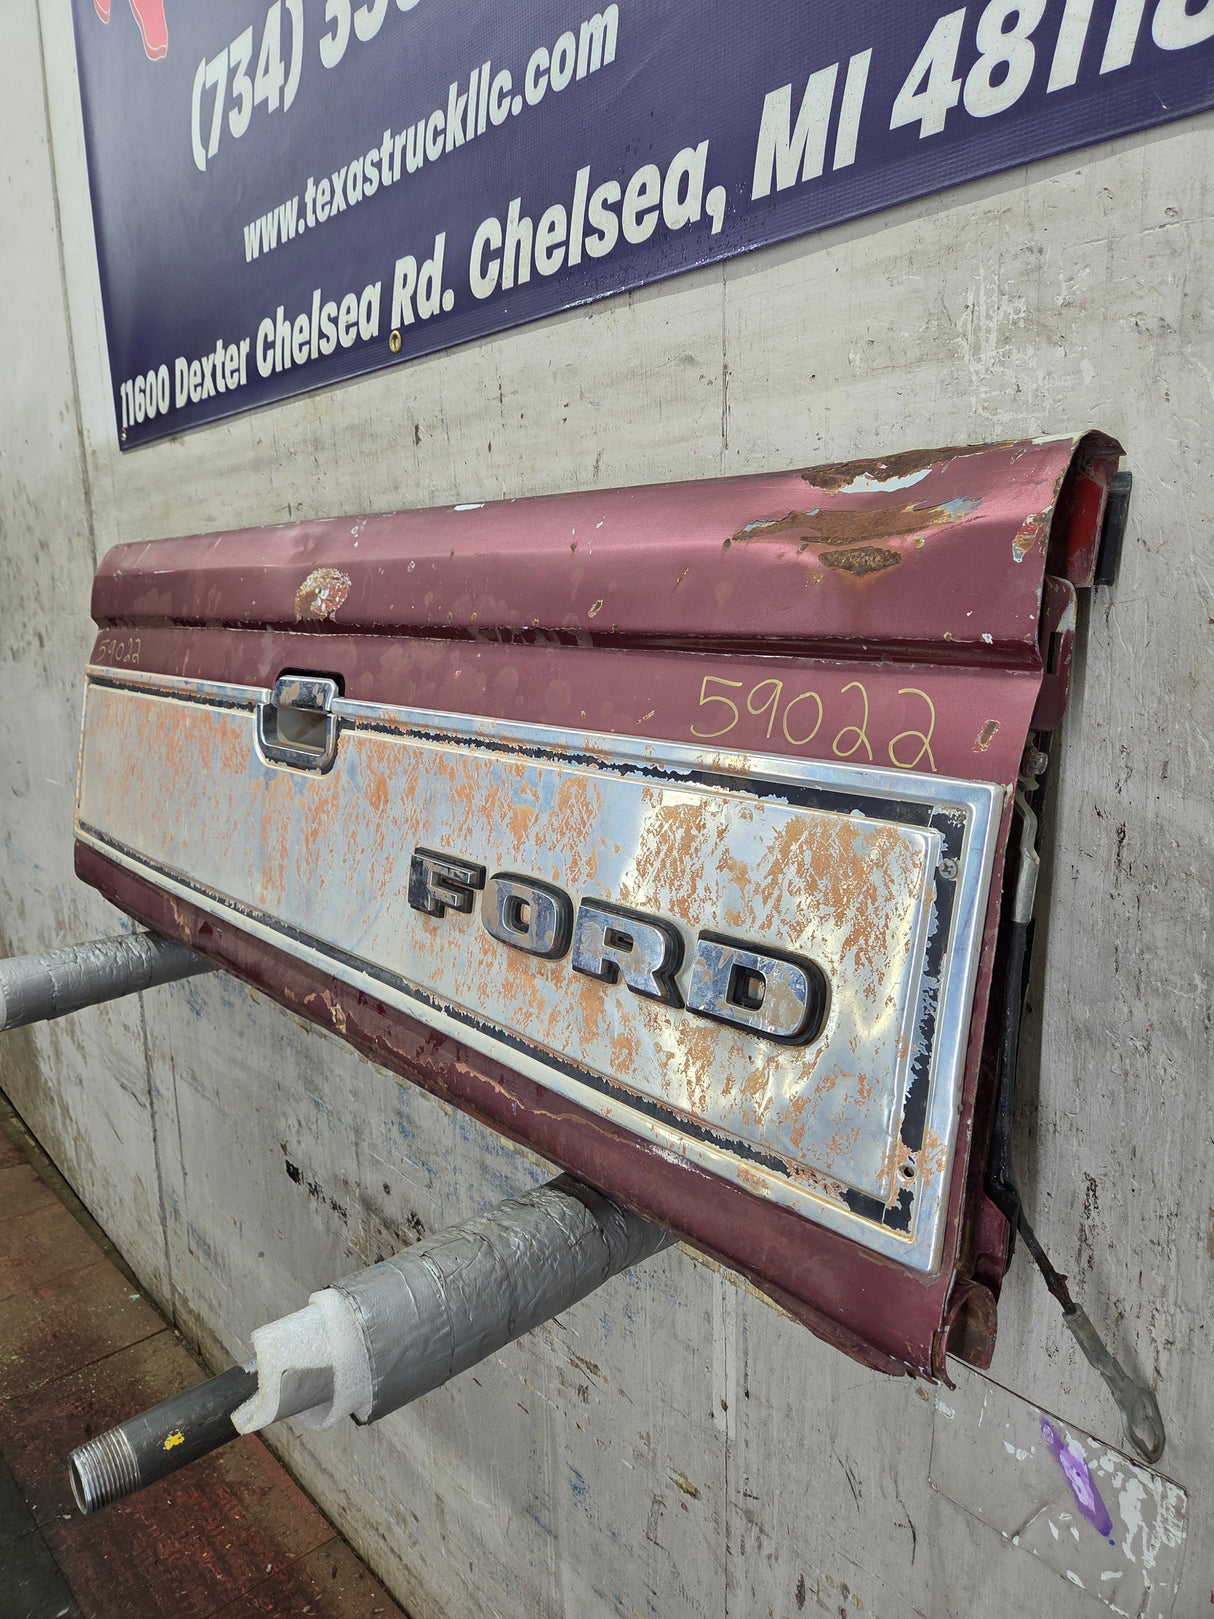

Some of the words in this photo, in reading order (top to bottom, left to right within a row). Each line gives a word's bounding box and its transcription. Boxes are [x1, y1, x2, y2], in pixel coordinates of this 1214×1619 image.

[191, 0, 304, 172] (734)
[243, 3, 619, 262] www.texastruckllc.com
[120, 363, 170, 428] 11600
[175, 336, 250, 409] Dexter
[256, 281, 382, 378] Chelsea
[391, 232, 455, 330] Rd.
[469, 139, 727, 299] Chelsea,
[751, 47, 873, 201] MI
[95, 637, 141, 665] 59022
[690, 675, 938, 772] 59022
[407, 846, 831, 1047] FORD
